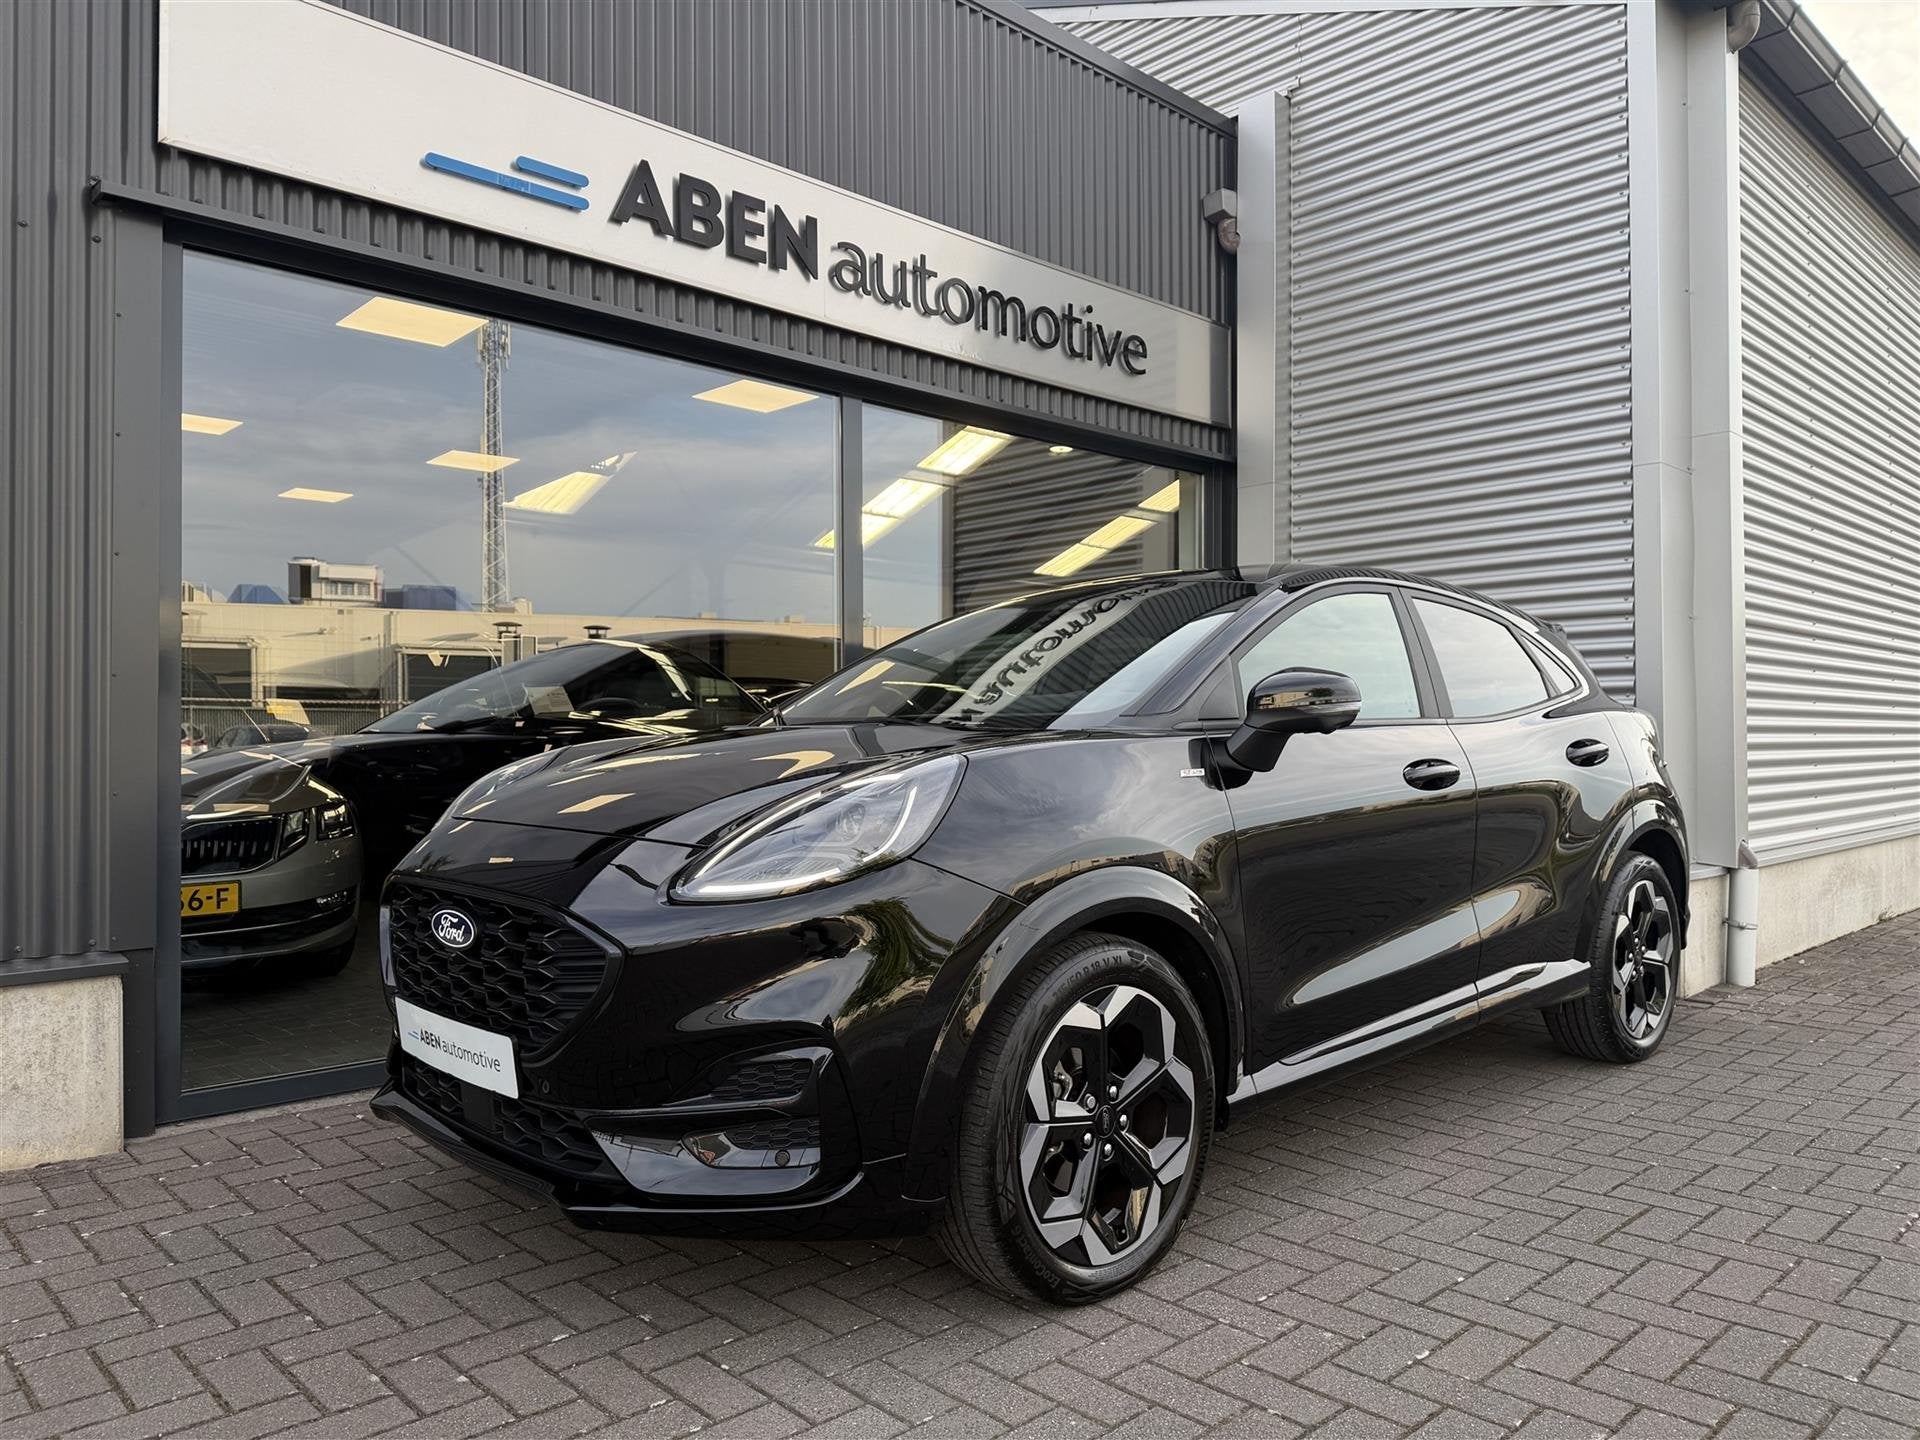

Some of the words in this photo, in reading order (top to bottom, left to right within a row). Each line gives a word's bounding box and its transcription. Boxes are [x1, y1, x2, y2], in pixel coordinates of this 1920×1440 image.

[611, 158, 819, 280] ABEN
[830, 241, 1148, 375] automotive
[180, 887, 229, 912] 6-F
[438, 914, 466, 942] Ford
[419, 1028, 442, 1050] ABEN
[441, 1039, 501, 1073] automotive
